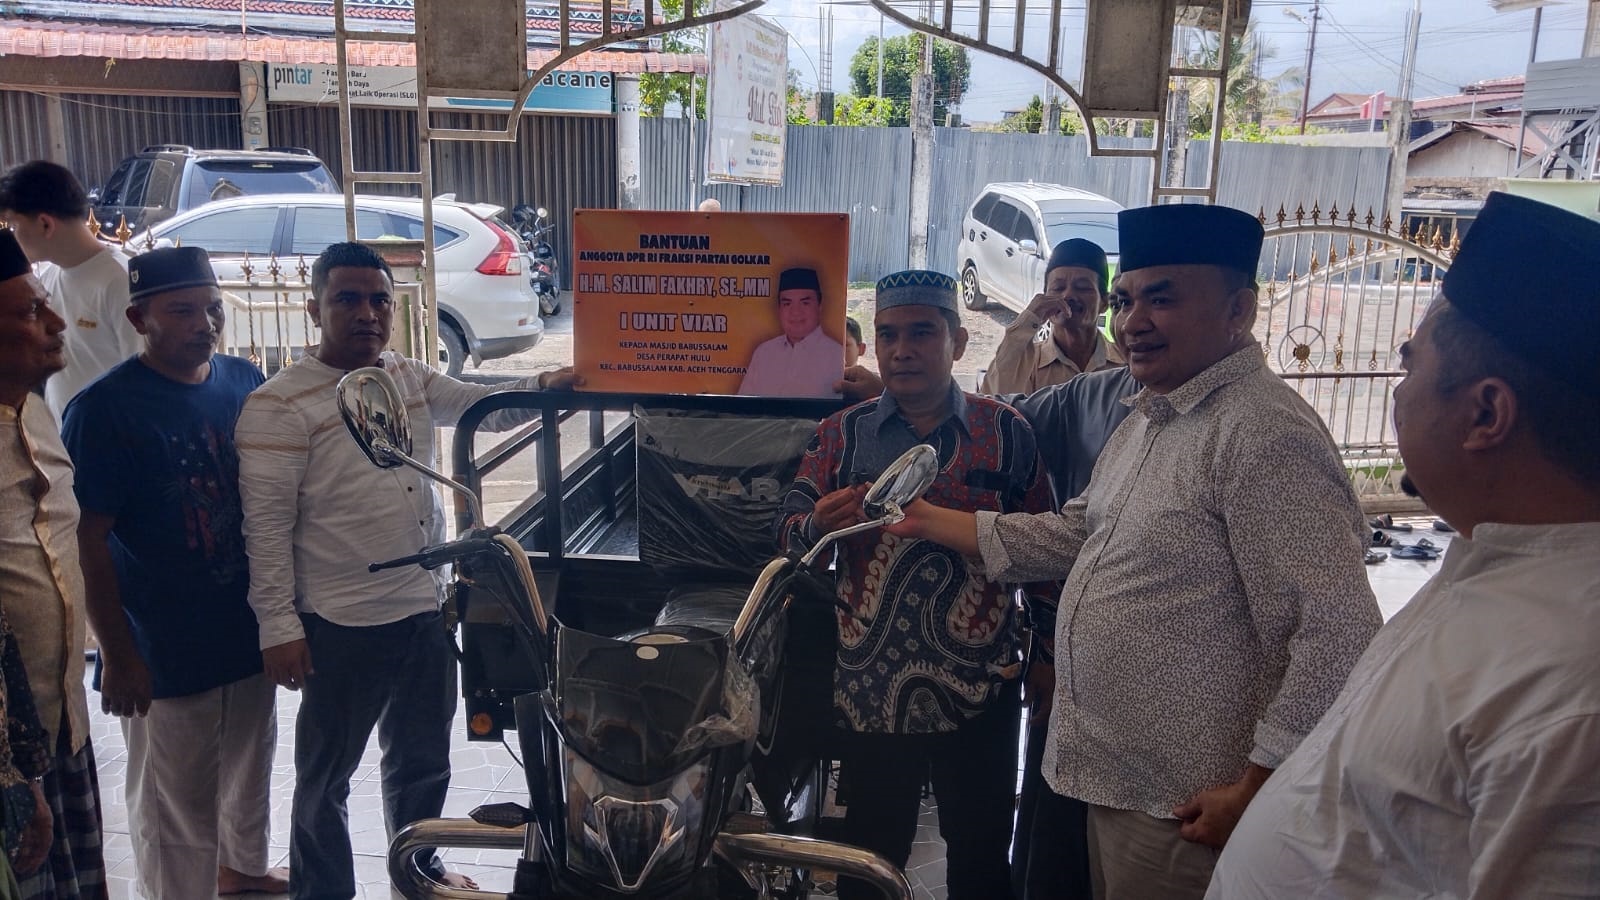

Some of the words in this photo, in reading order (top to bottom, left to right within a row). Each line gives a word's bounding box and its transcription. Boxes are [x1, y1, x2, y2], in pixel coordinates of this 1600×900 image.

[274, 66, 313, 90] pintar
[353, 80, 370, 88] Daya
[373, 91, 399, 99] Operasi
[639, 234, 710, 250] BANTUAN
[579, 251, 625, 262] ANGGOTA
[626, 252, 646, 263] DPR
[647, 253, 658, 263] RI
[659, 253, 694, 264] FRAKSI
[695, 254, 730, 264] PARTAI
[731, 255, 770, 265] GOLKAR
[578, 273, 610, 293] H.M.
[612, 274, 657, 295] SALIM
[660, 276, 716, 297] FAKHRY,
[632, 312, 678, 332] UNIT
[681, 313, 728, 333] VIAR
[619, 341, 647, 349] KEPADA
[649, 342, 677, 350] MASJID
[678, 342, 728, 351] BABUSSALAM
[636, 353, 655, 361] DESA
[656, 353, 688, 361] PERAPAT
[690, 354, 711, 362] HULU
[600, 363, 615, 371] KEC.
[617, 364, 667, 372] BABUSSALAM
[668, 365, 685, 373] KAB.
[687, 366, 707, 374] ACEH
[708, 366, 747, 375] TENGGARA
